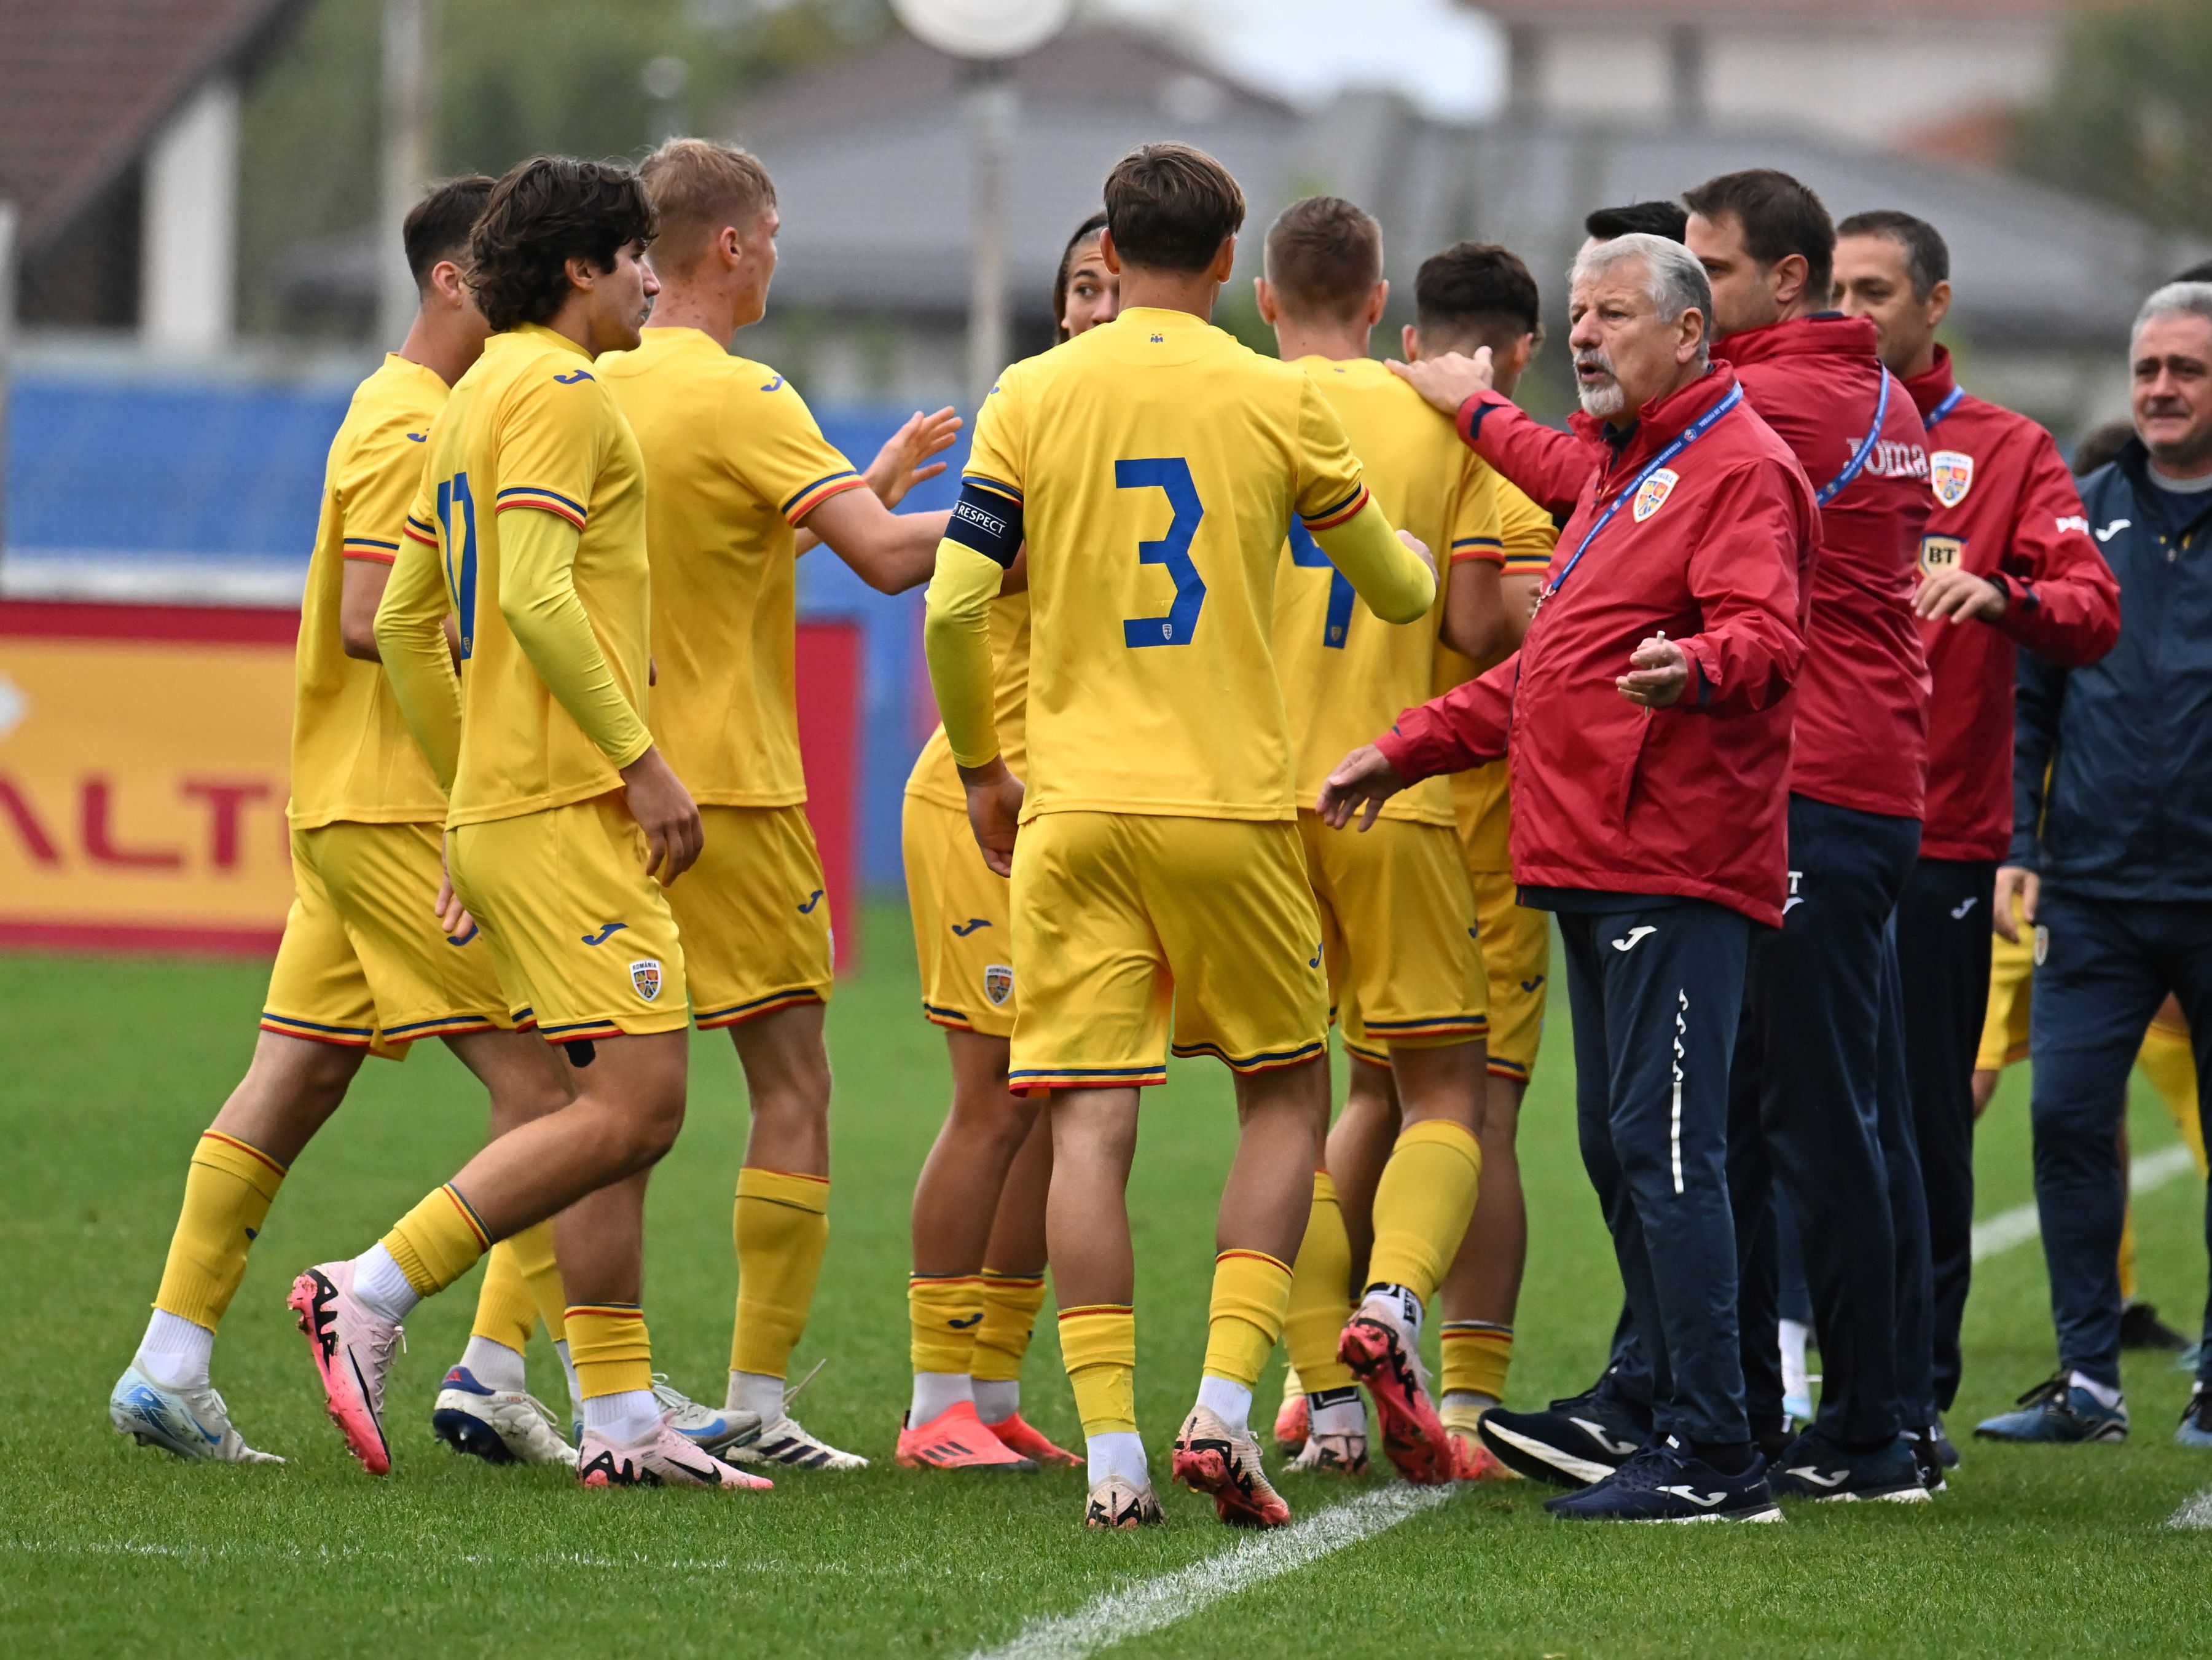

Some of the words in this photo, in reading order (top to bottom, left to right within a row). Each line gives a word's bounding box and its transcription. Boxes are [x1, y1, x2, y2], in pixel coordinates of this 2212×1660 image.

[958, 505, 1006, 534] RESPECT
[1115, 457, 1206, 648] 3
[1929, 546, 1957, 564] BT
